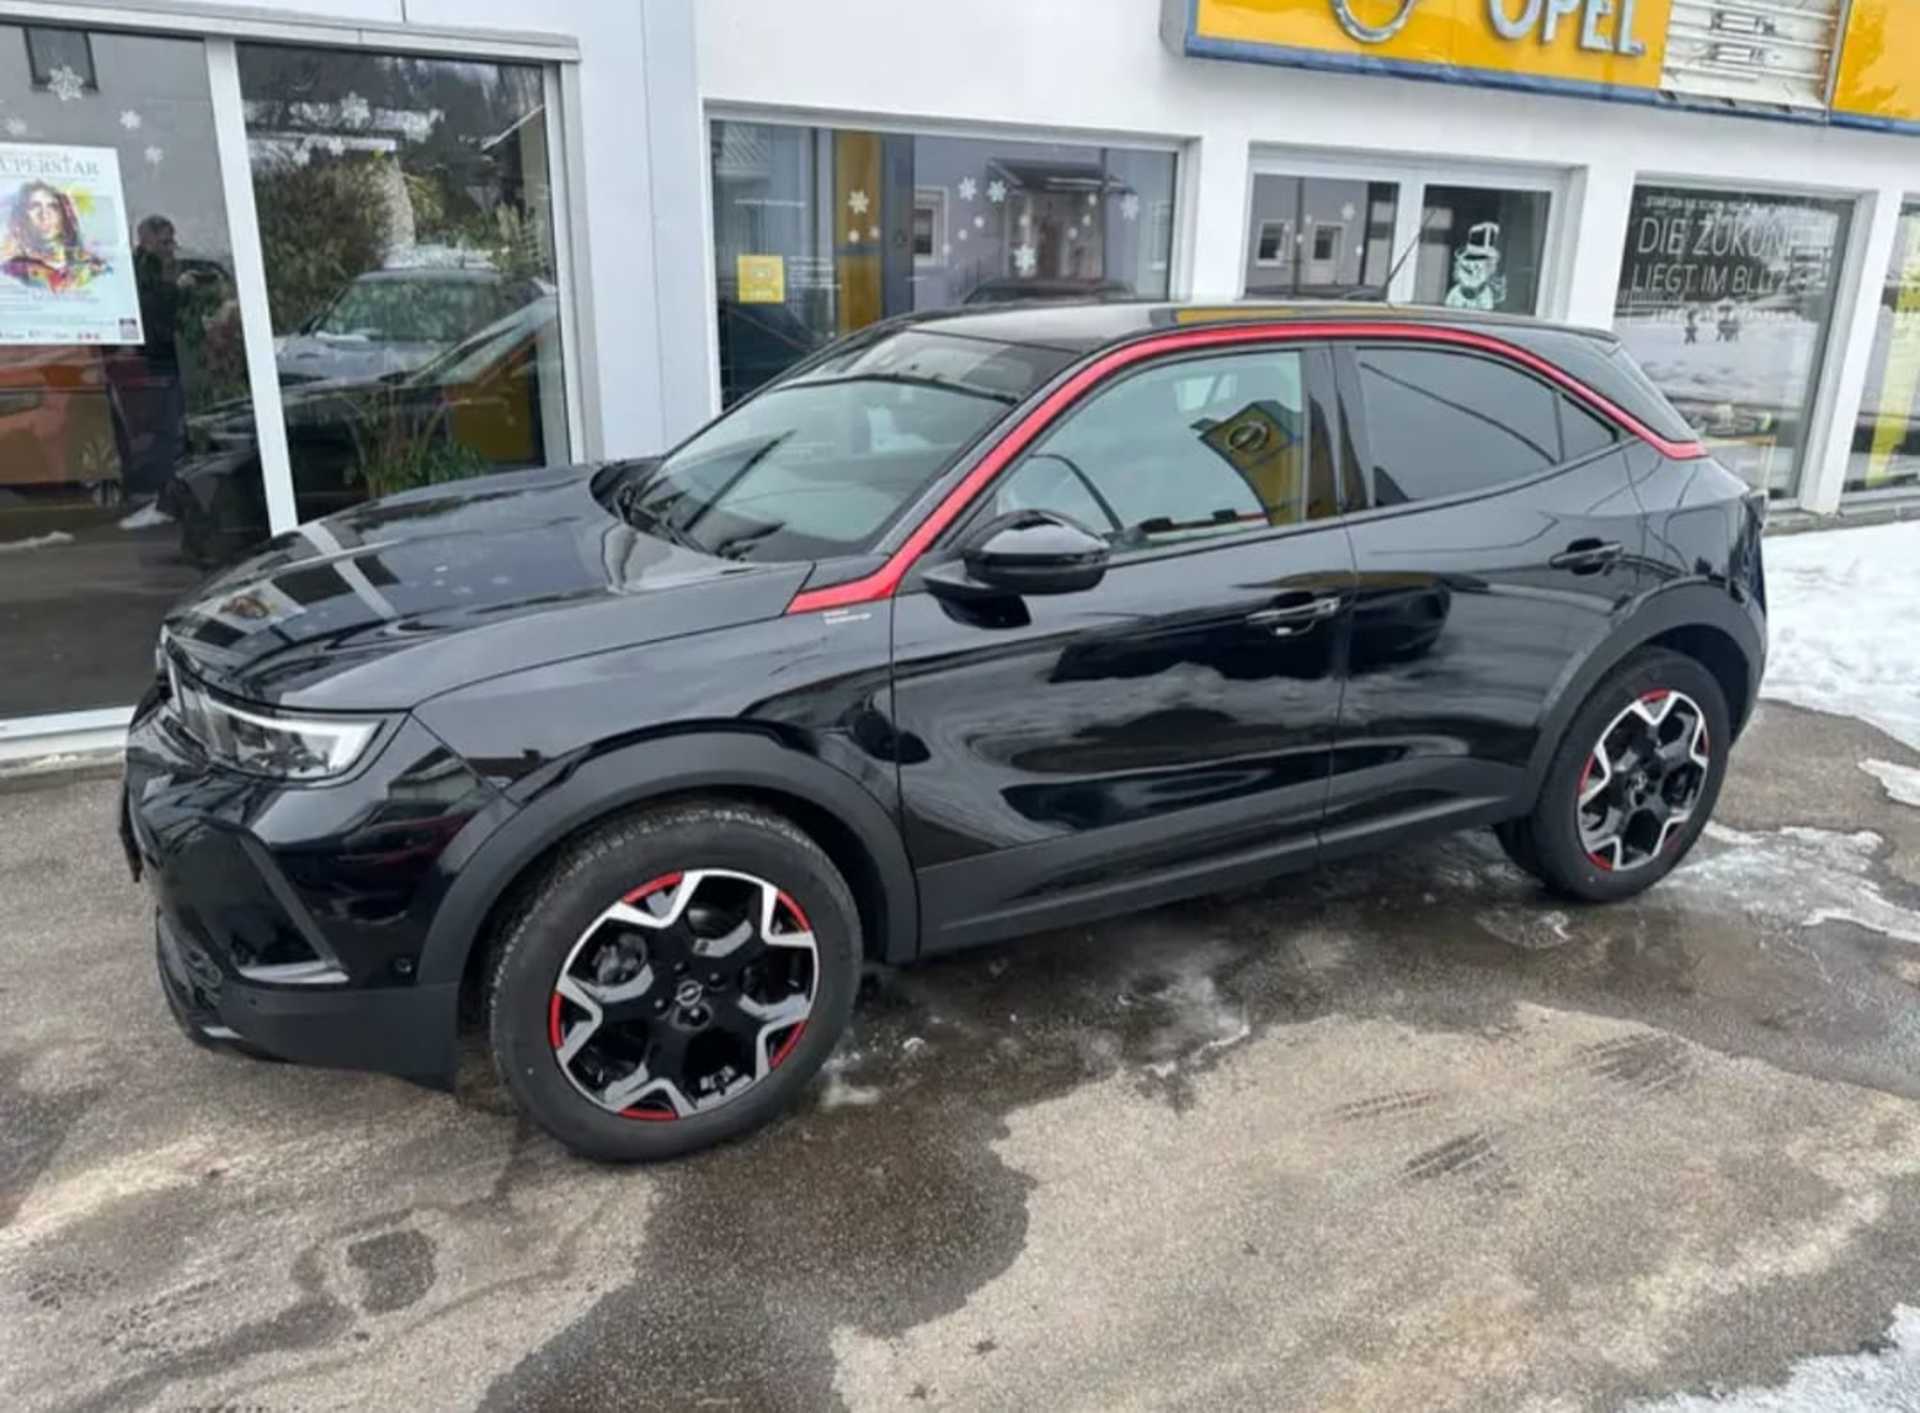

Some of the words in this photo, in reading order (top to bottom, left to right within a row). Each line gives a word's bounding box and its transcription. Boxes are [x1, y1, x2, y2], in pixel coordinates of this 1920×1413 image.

[1488, 0, 1646, 55] OPEL
[1637, 217, 1688, 254] DIE
[1631, 263, 1699, 293] LIEGT
[1701, 265, 1729, 295] IM
